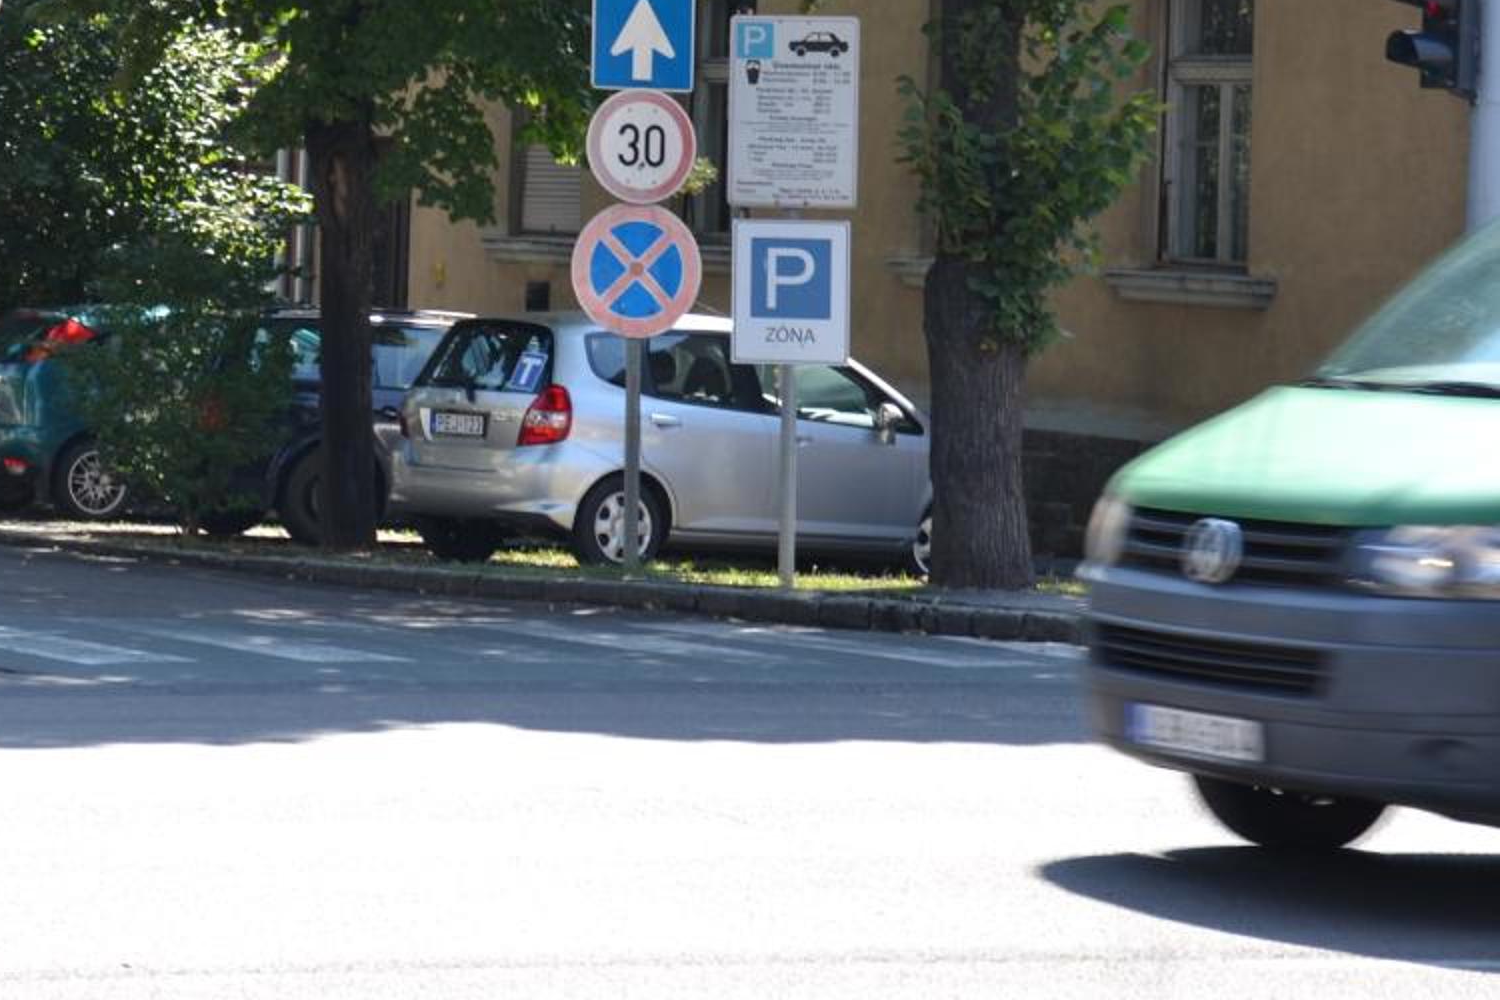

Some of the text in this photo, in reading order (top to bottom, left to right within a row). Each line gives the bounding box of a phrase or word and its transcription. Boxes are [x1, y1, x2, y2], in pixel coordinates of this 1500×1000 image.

[744, 25, 767, 56] P
[617, 123, 665, 168] 30
[766, 247, 815, 309] P
[520, 356, 542, 385] T
